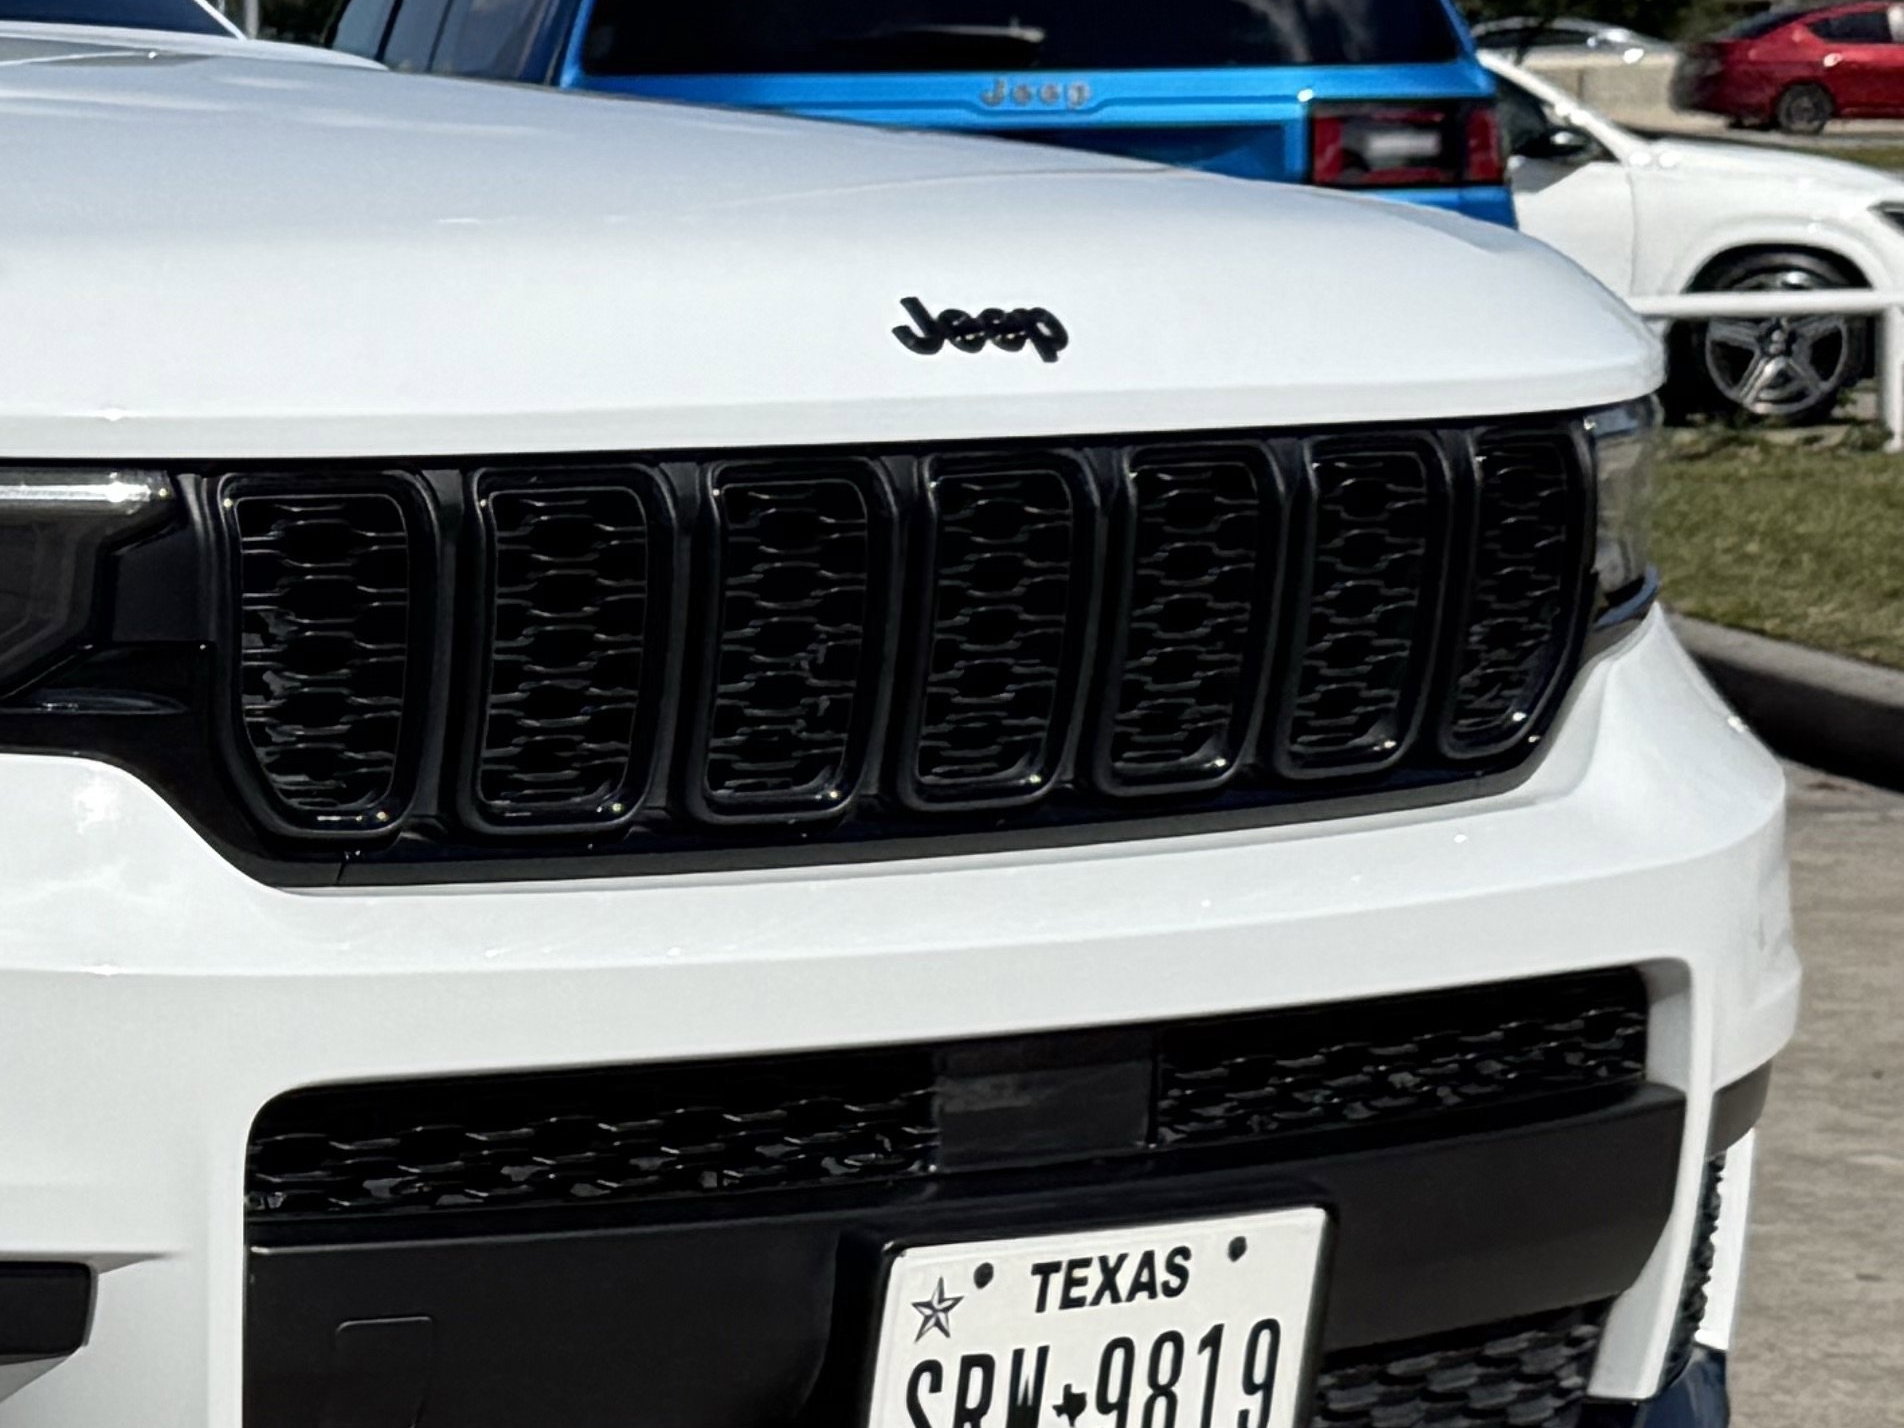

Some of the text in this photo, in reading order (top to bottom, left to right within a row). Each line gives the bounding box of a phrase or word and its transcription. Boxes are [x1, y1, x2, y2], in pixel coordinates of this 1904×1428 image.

[981, 79, 1090, 109] Jeep
[892, 296, 1069, 363] Jeep
[1031, 1245, 1193, 1314] TEXAS
